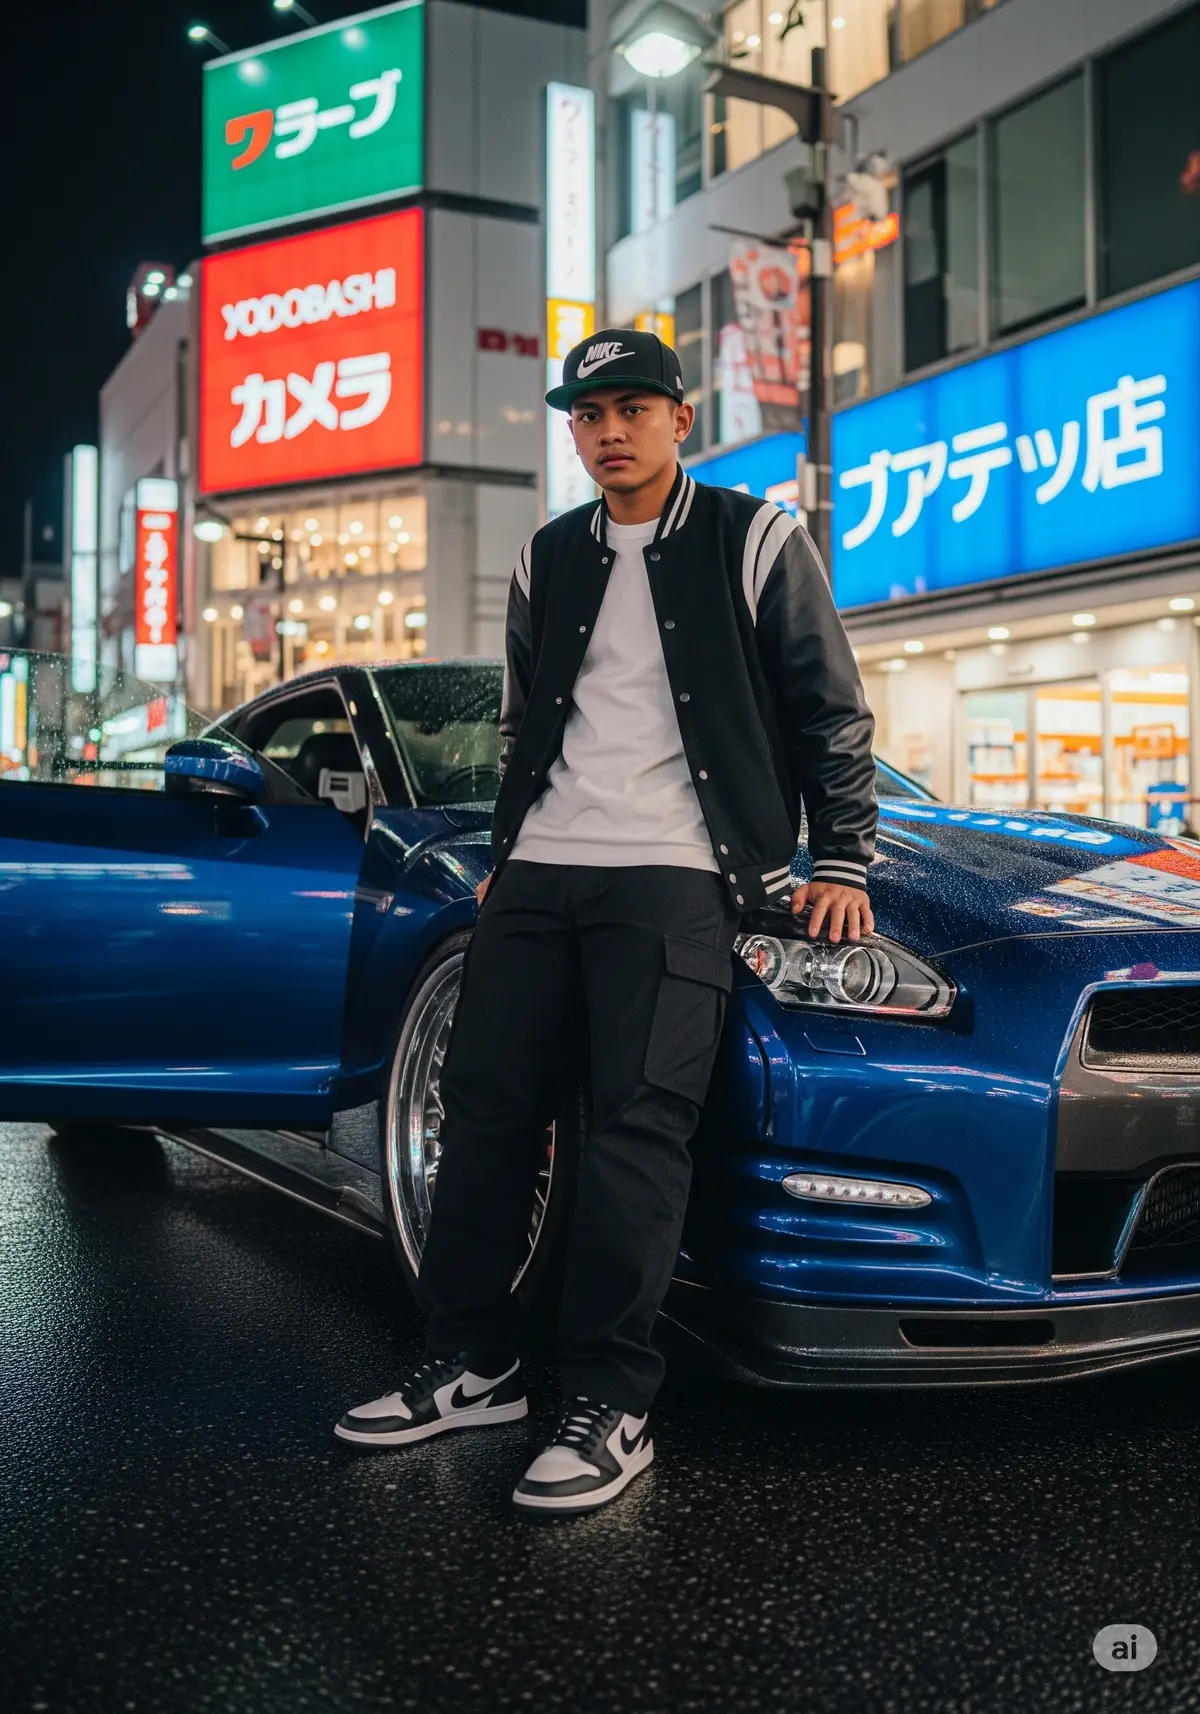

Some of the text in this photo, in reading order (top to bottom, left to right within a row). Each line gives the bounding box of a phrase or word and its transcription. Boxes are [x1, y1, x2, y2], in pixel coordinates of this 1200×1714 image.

[221, 267, 396, 341] YODOBASHI
[584, 341, 623, 363] NIKE
[230, 352, 391, 448] カメラ
